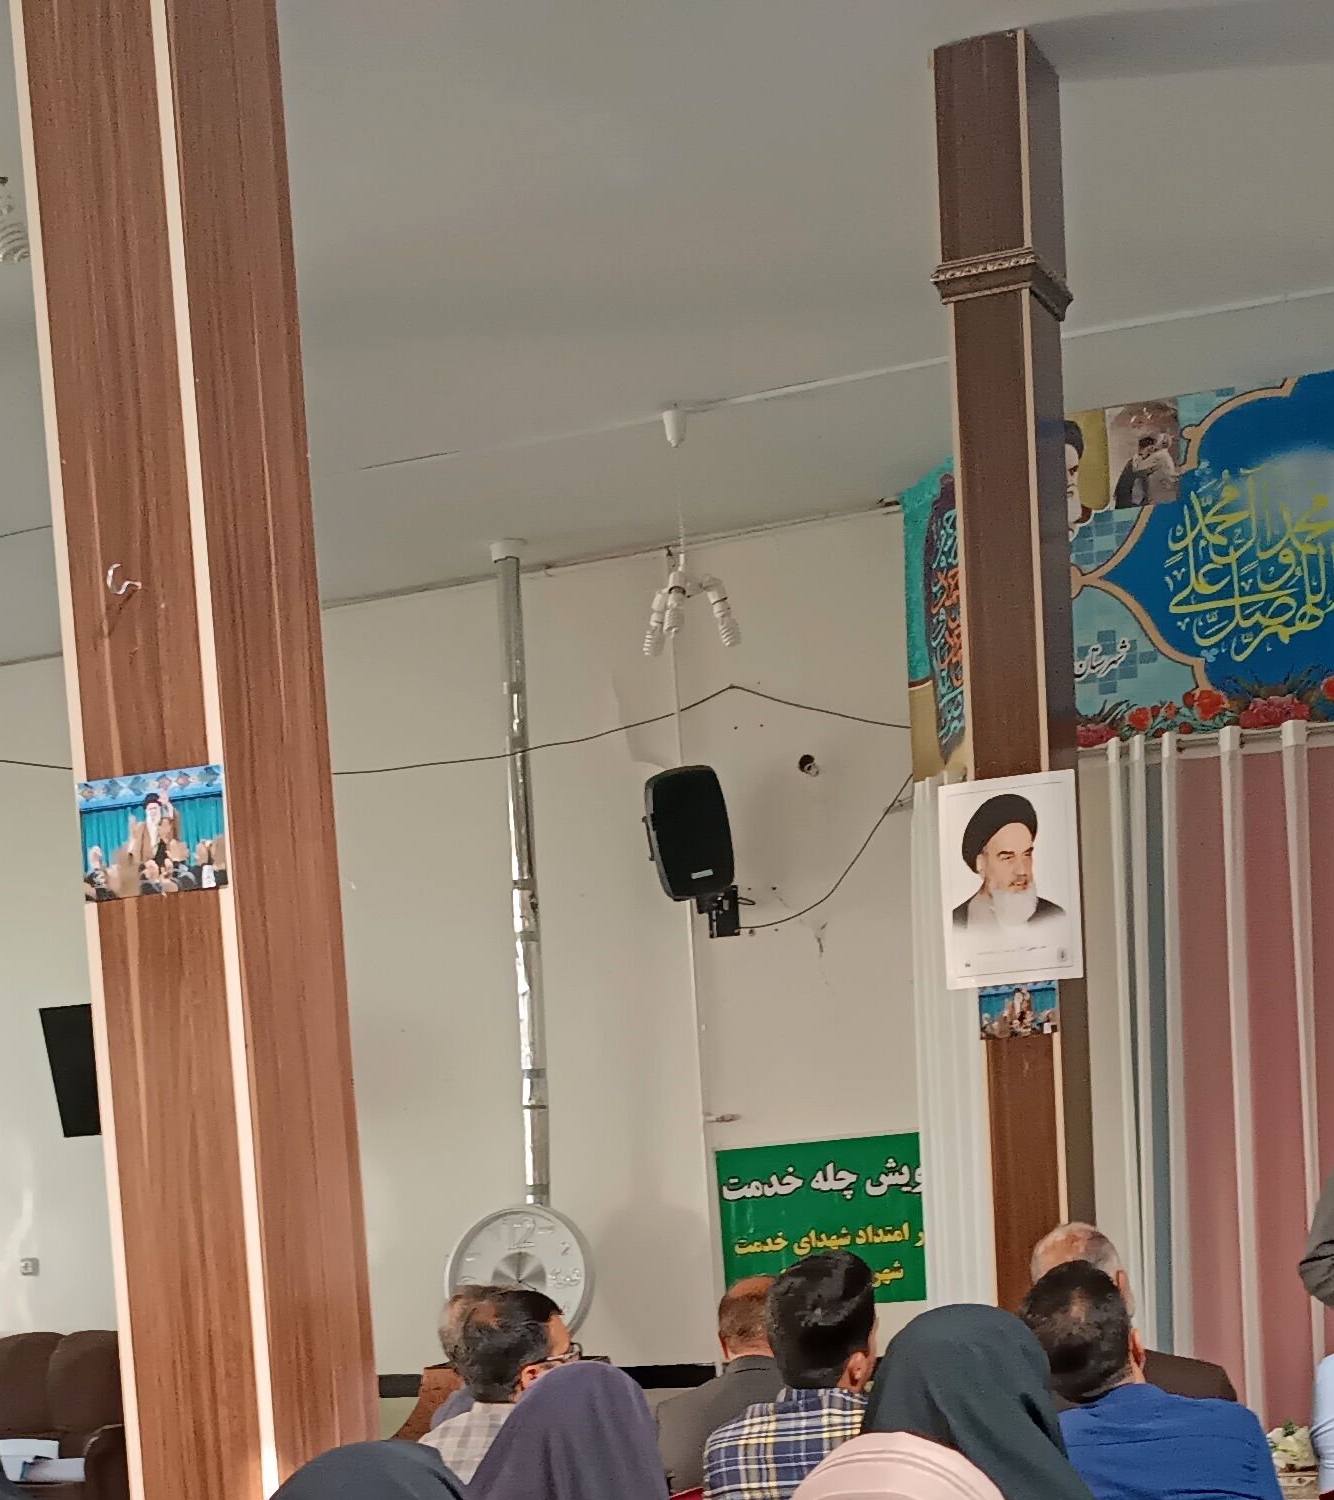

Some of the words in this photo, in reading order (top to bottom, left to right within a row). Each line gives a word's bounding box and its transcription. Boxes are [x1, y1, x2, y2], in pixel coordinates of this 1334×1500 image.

[722, 1166, 804, 1201] خدمت
[811, 1161, 858, 1200] چله
[734, 1231, 788, 1256] خدمت
[793, 1227, 851, 1256] شهدای
[856, 1222, 910, 1246] امتداد
